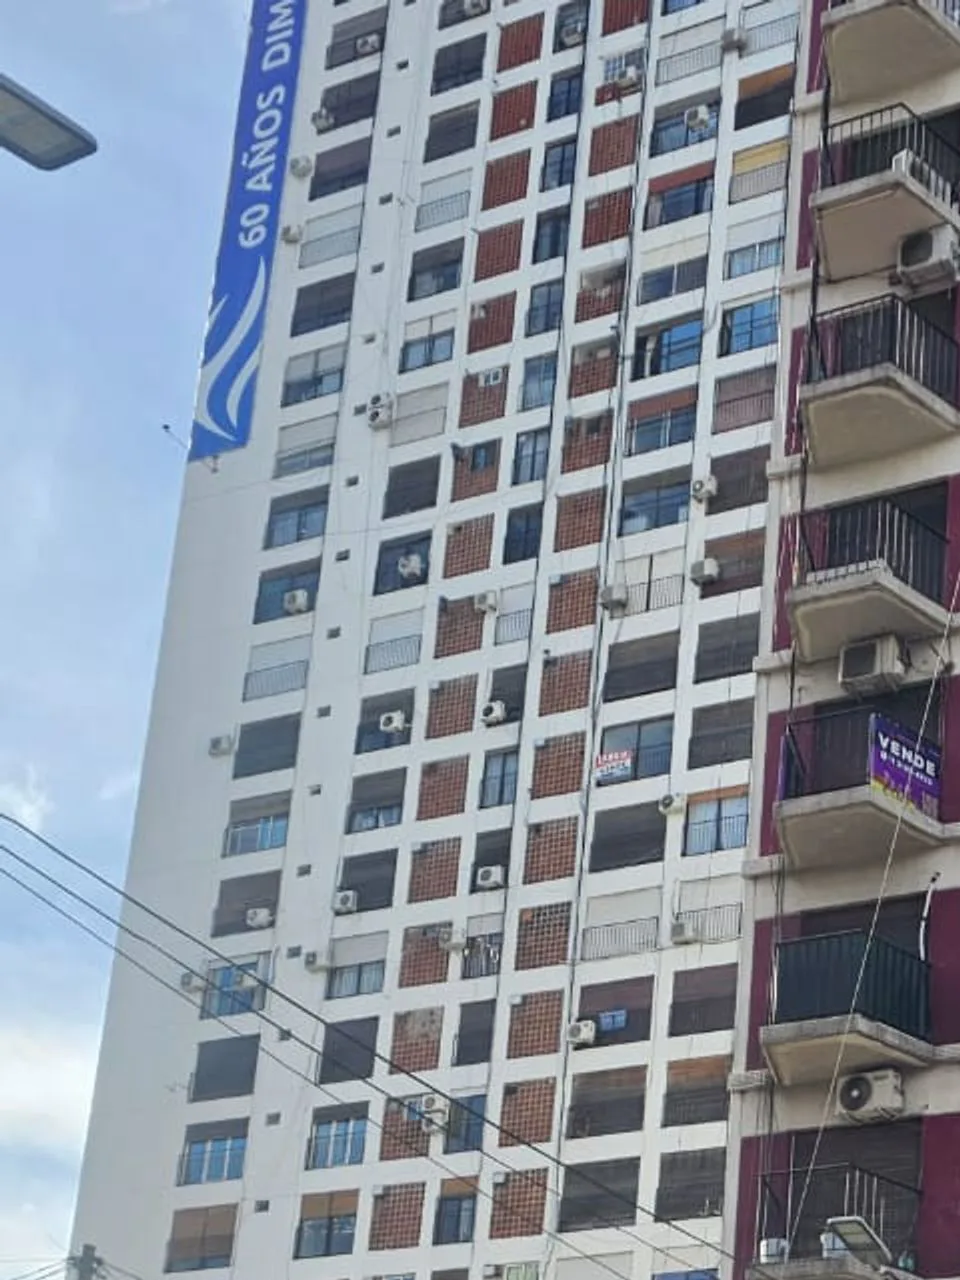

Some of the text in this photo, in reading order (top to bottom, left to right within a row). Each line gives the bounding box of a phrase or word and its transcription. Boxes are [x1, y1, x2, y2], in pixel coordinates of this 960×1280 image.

[242, 83, 285, 192] AÑOS
[238, 203, 269, 249] 60
[878, 731, 936, 777] VENDE
